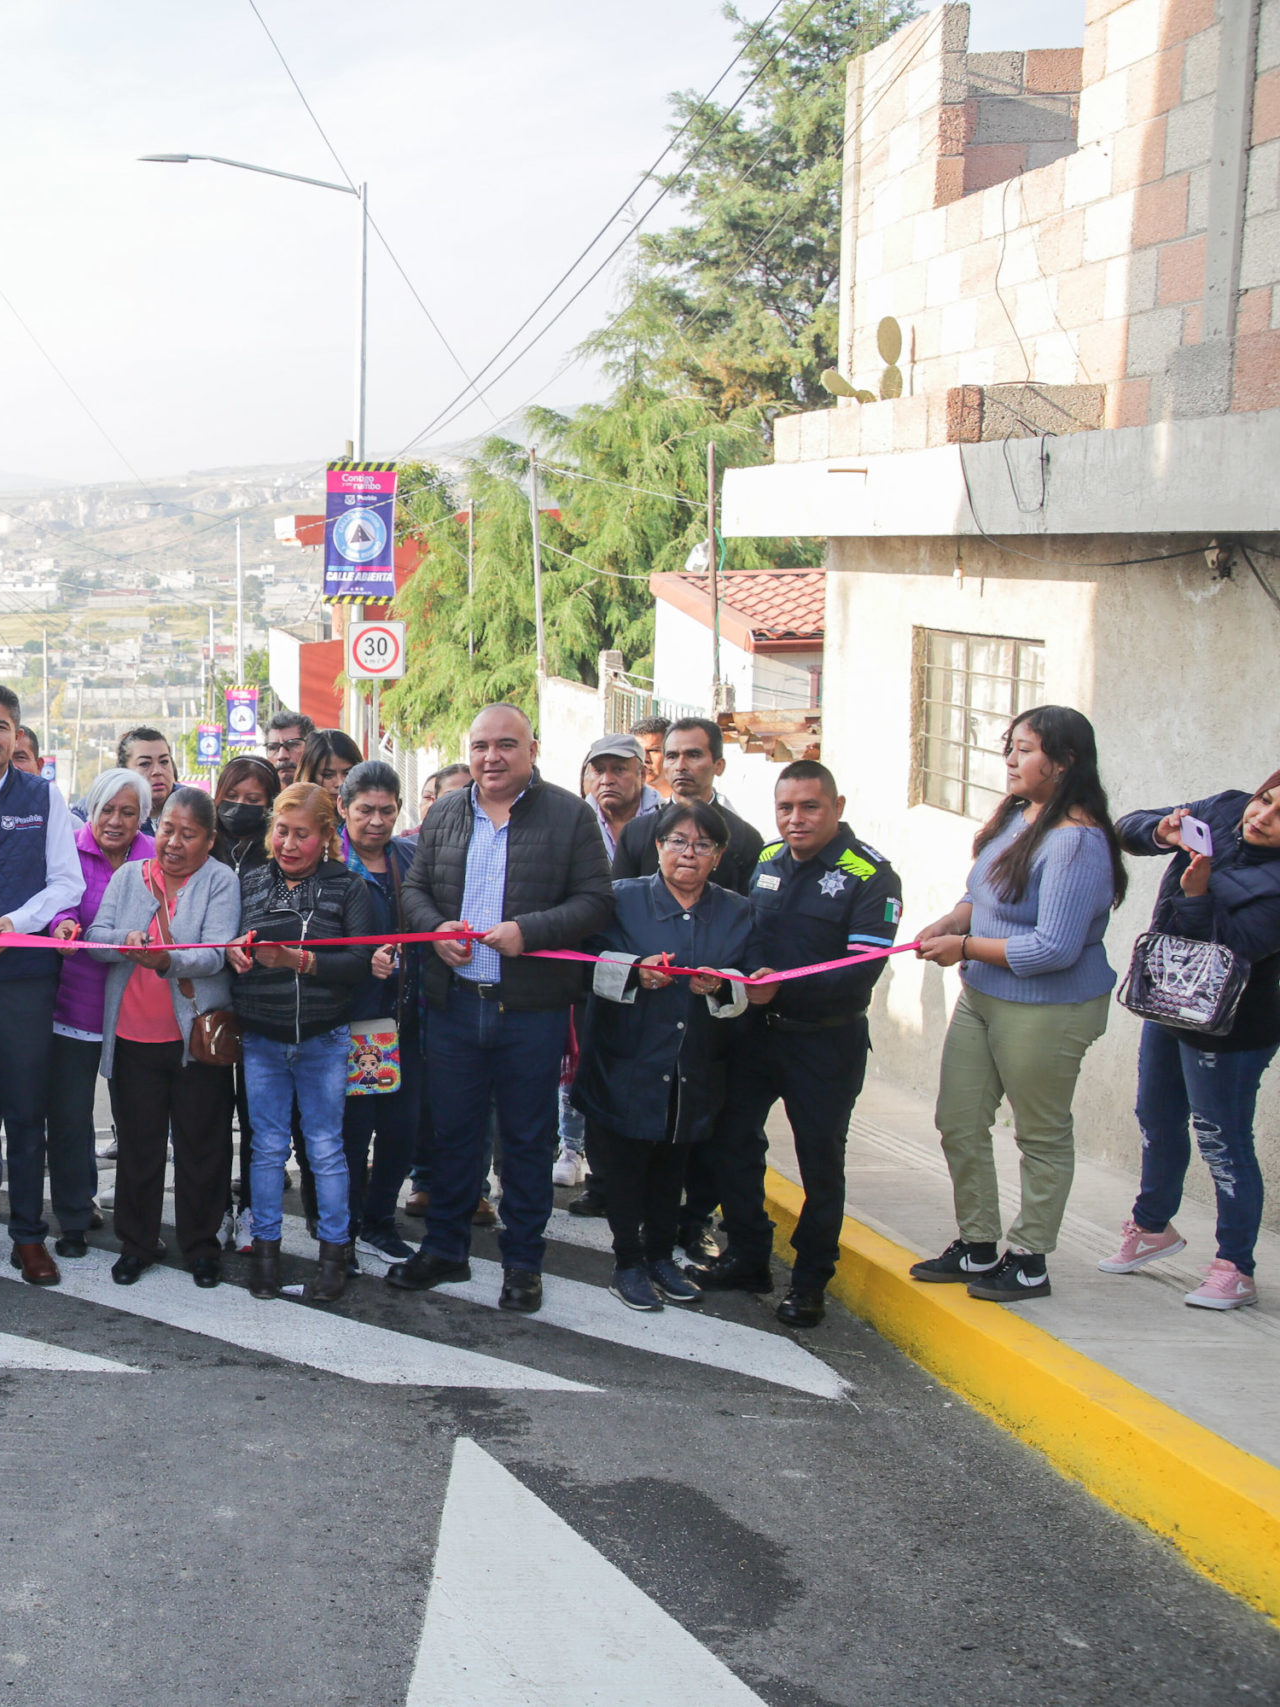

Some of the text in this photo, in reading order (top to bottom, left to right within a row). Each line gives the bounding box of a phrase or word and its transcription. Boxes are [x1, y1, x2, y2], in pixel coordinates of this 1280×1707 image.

[341, 473, 375, 484] Contigo
[353, 482, 381, 490] rumbo
[326, 571, 392, 582] CALLE ABIERTA
[364, 637, 388, 656] 30
